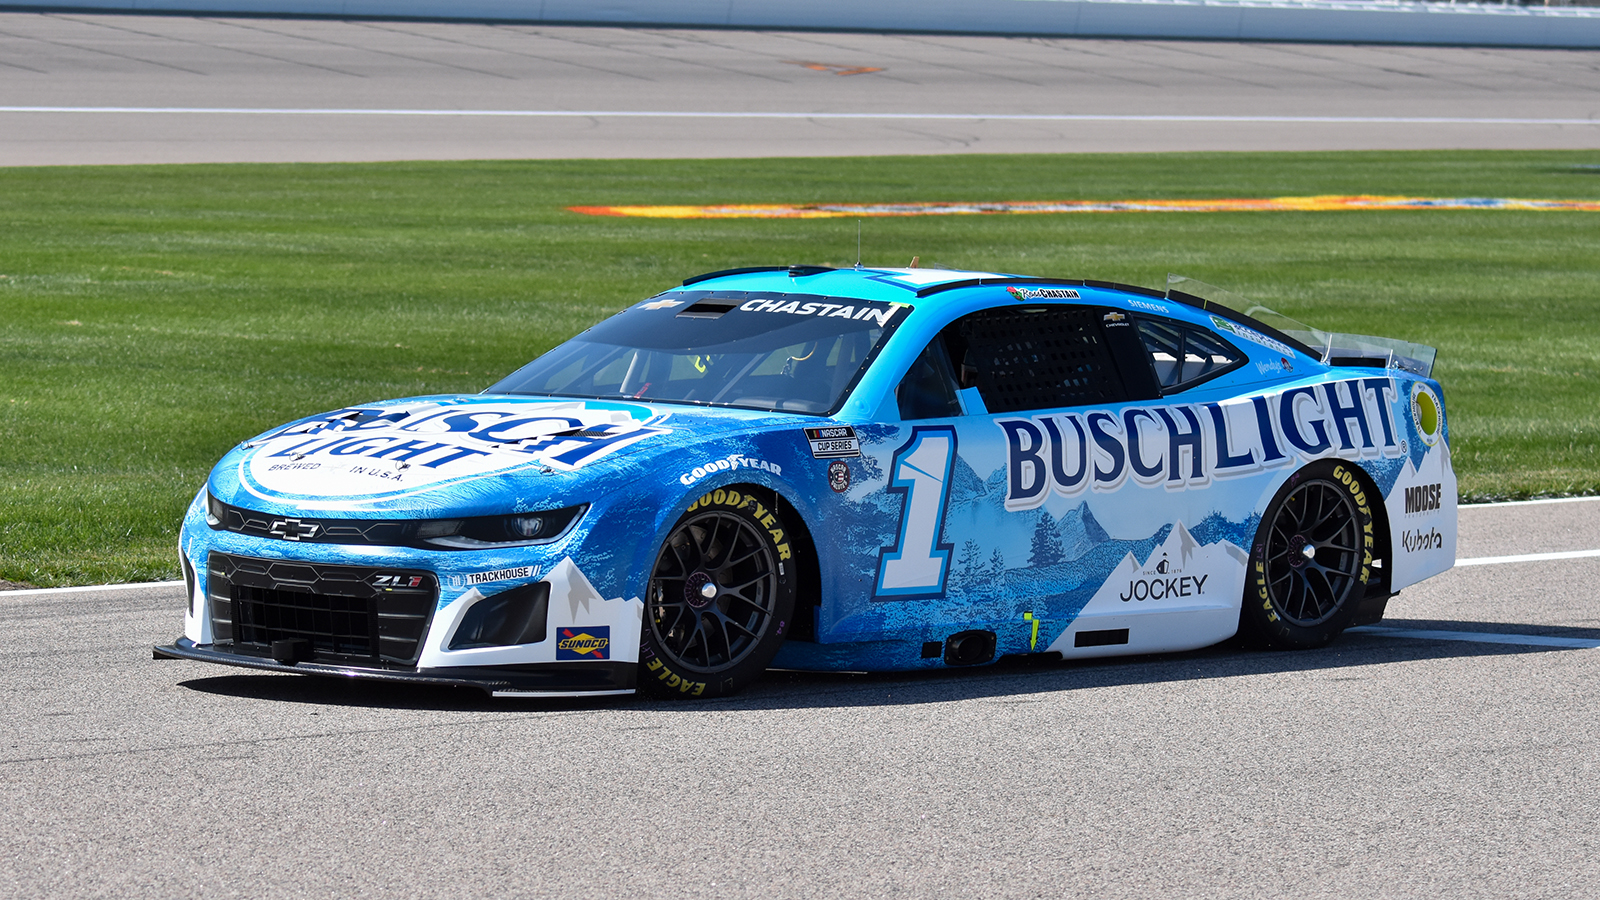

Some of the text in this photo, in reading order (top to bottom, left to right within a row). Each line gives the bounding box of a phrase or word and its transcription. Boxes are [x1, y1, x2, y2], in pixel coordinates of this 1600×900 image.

[1039, 288, 1080, 299] CHASTAIN
[739, 299, 888, 323] CHASTAIN
[1127, 299, 1170, 314] SIEMENS
[821, 428, 848, 438] NASCAR
[998, 377, 1398, 500] BUSCH LIGHT
[264, 436, 493, 469] LIGHT
[817, 440, 852, 451] CUP SERIES
[267, 463, 321, 472] BREWED
[349, 466, 366, 475] IN
[1404, 483, 1442, 514] MOOSE
[870, 425, 958, 600] 1
[1402, 526, 1442, 553] Kubota
[372, 575, 422, 588] ZL1
[469, 567, 530, 584] TRACKHOUSE
[1120, 574, 1208, 602] JOCKEY
[1256, 560, 1280, 623] EAGLE
[560, 638, 607, 650] SUNOCO
[646, 657, 706, 696] EAGLE
